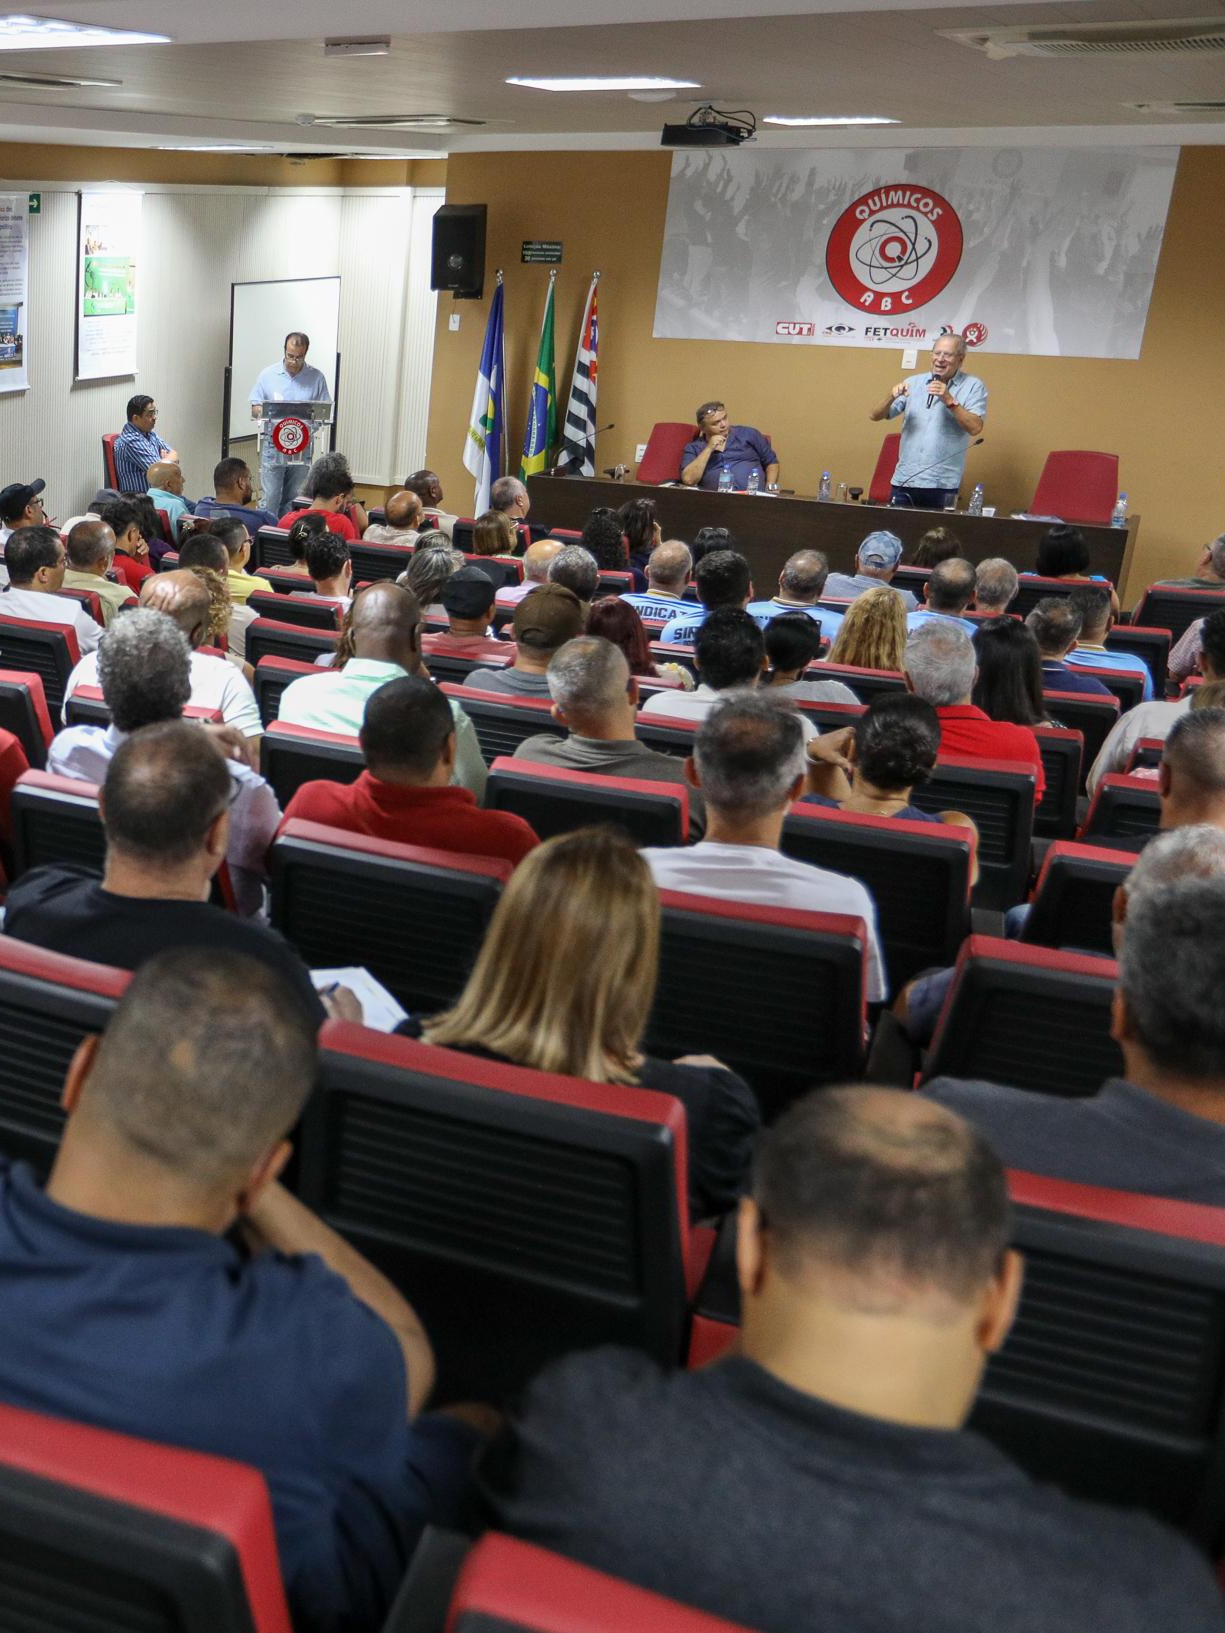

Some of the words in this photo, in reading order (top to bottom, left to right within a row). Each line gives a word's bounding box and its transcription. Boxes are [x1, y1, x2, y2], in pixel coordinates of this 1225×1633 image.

[855, 189, 943, 221] QUÍMICOS
[776, 323, 812, 335] CUT
[279, 419, 304, 429] QUÍMICOS
